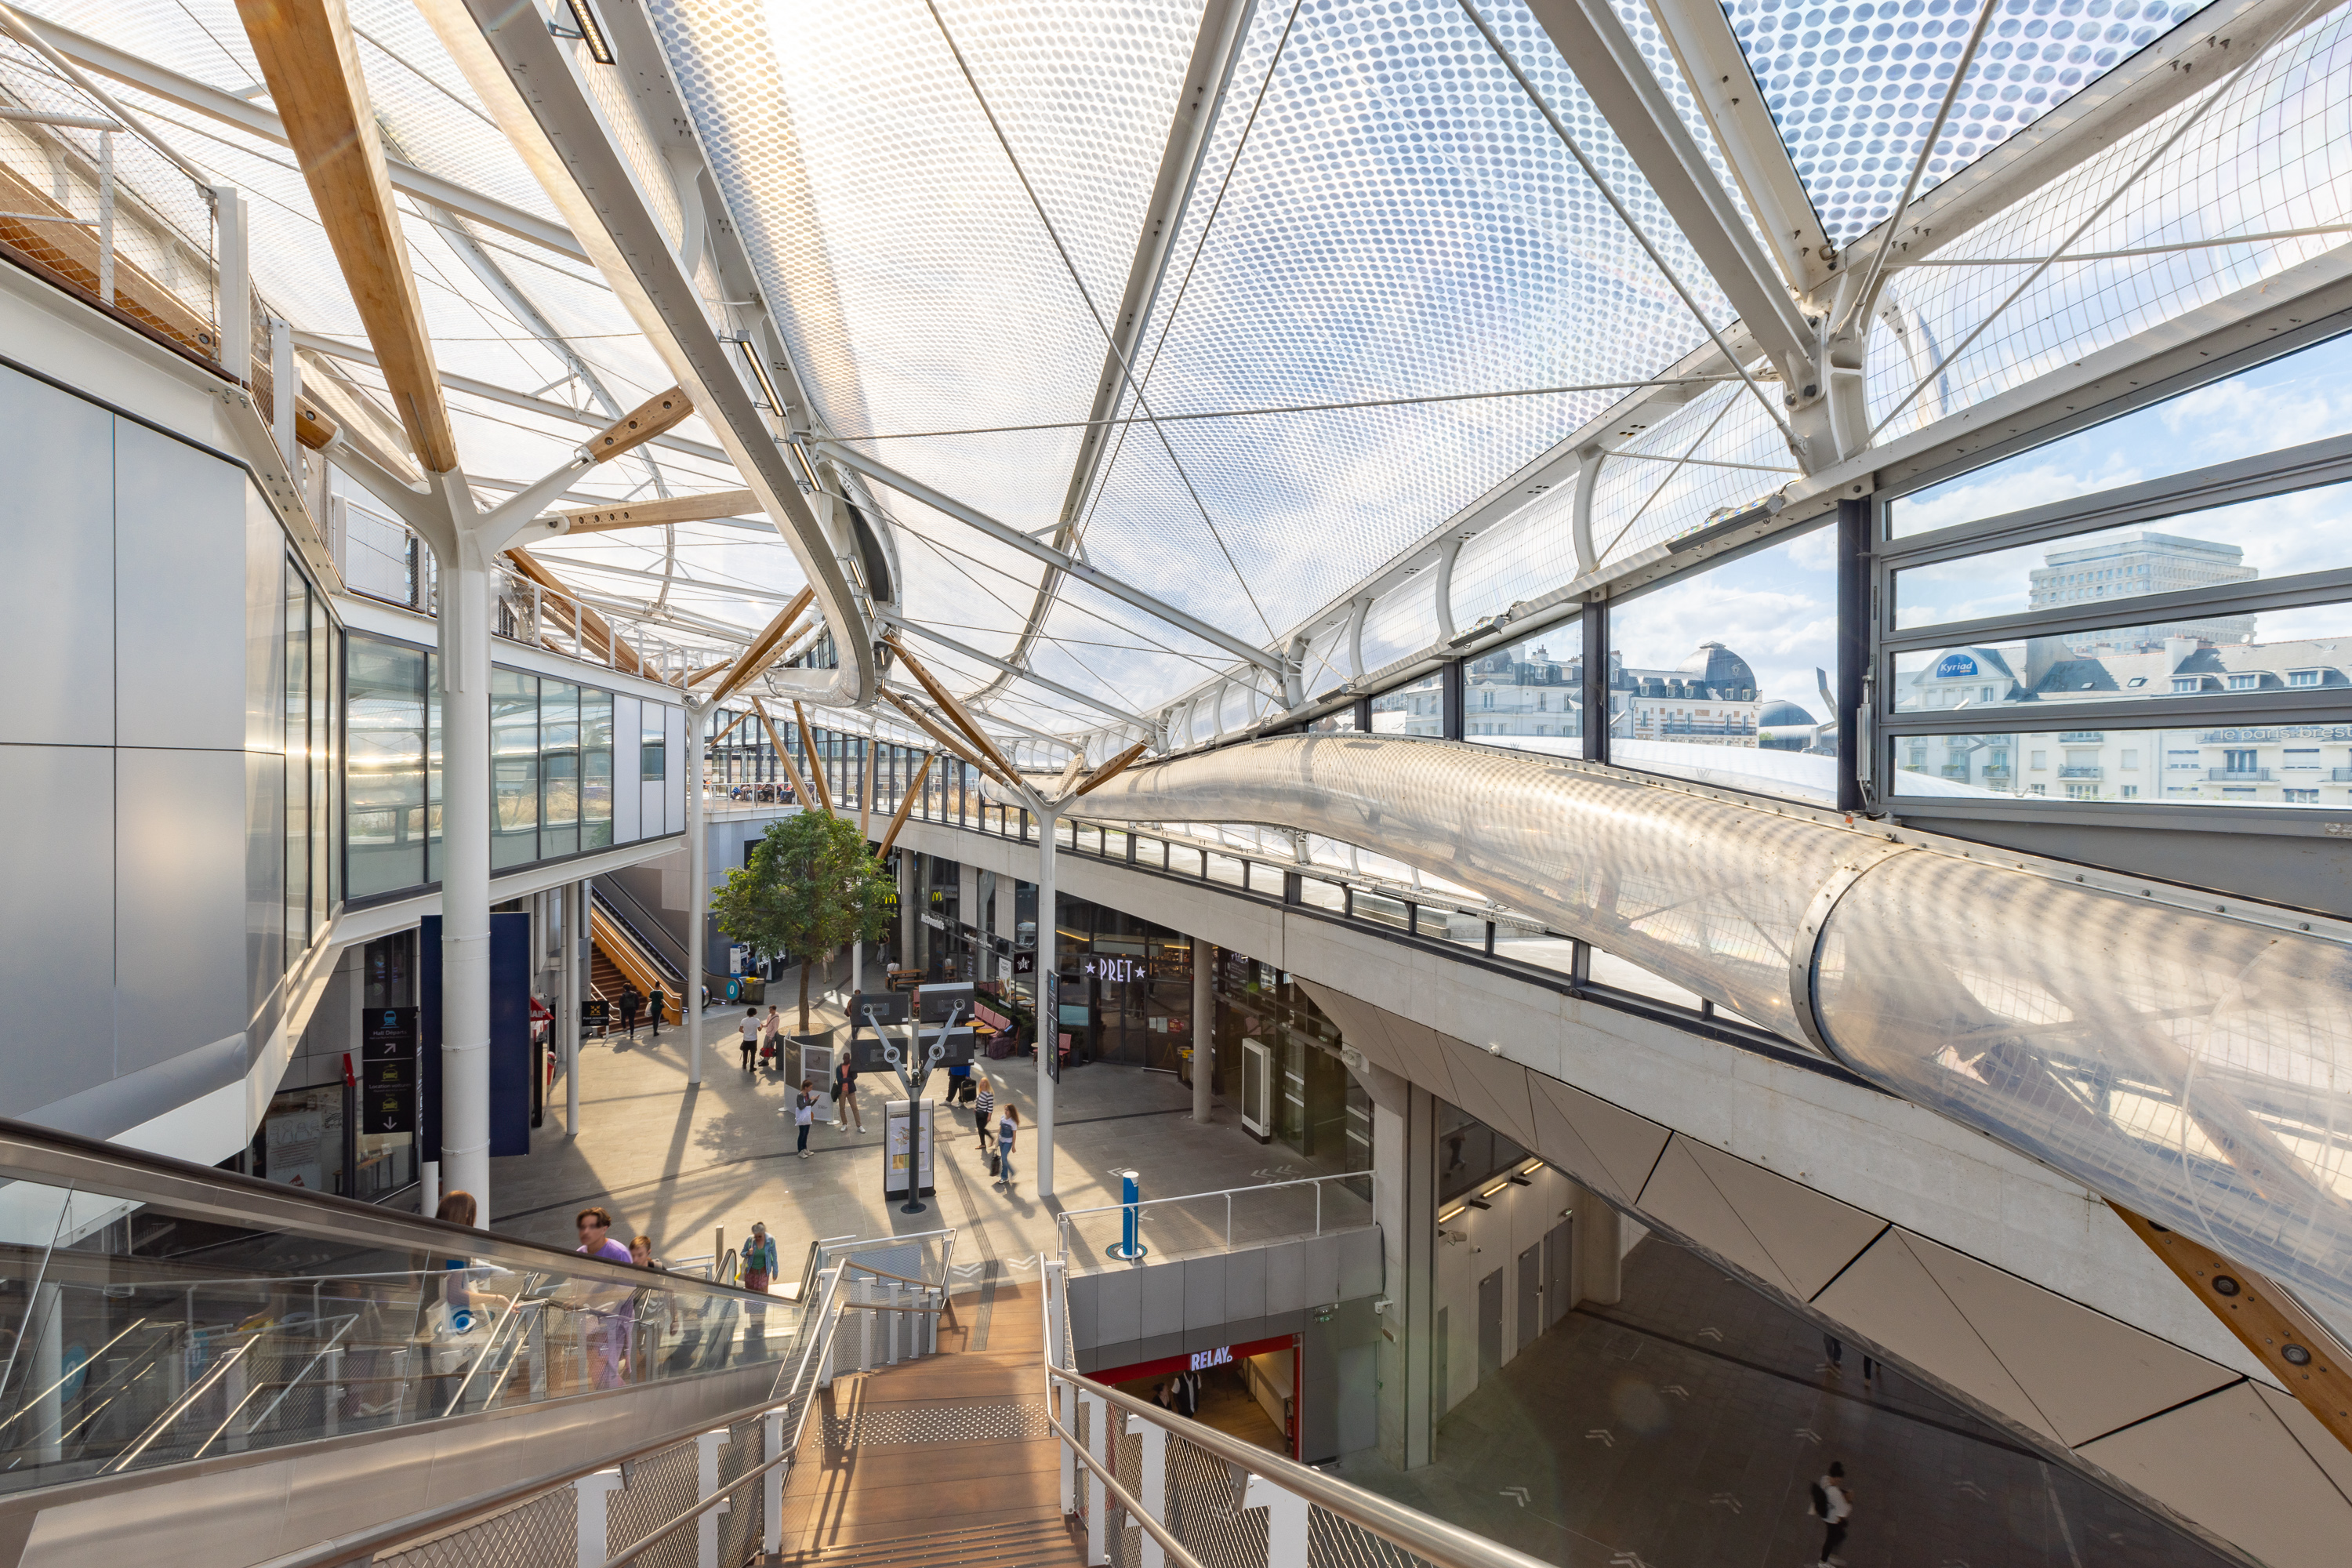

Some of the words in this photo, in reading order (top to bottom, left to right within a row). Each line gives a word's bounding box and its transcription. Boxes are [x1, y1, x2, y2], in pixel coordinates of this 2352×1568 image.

[1940, 662, 1973, 673] Kyriad
[2220, 729, 2235, 739] le
[2241, 726, 2352, 741] paris-brest
[1100, 958, 1133, 982] PRET
[1191, 1345, 1230, 1371] RELAY
